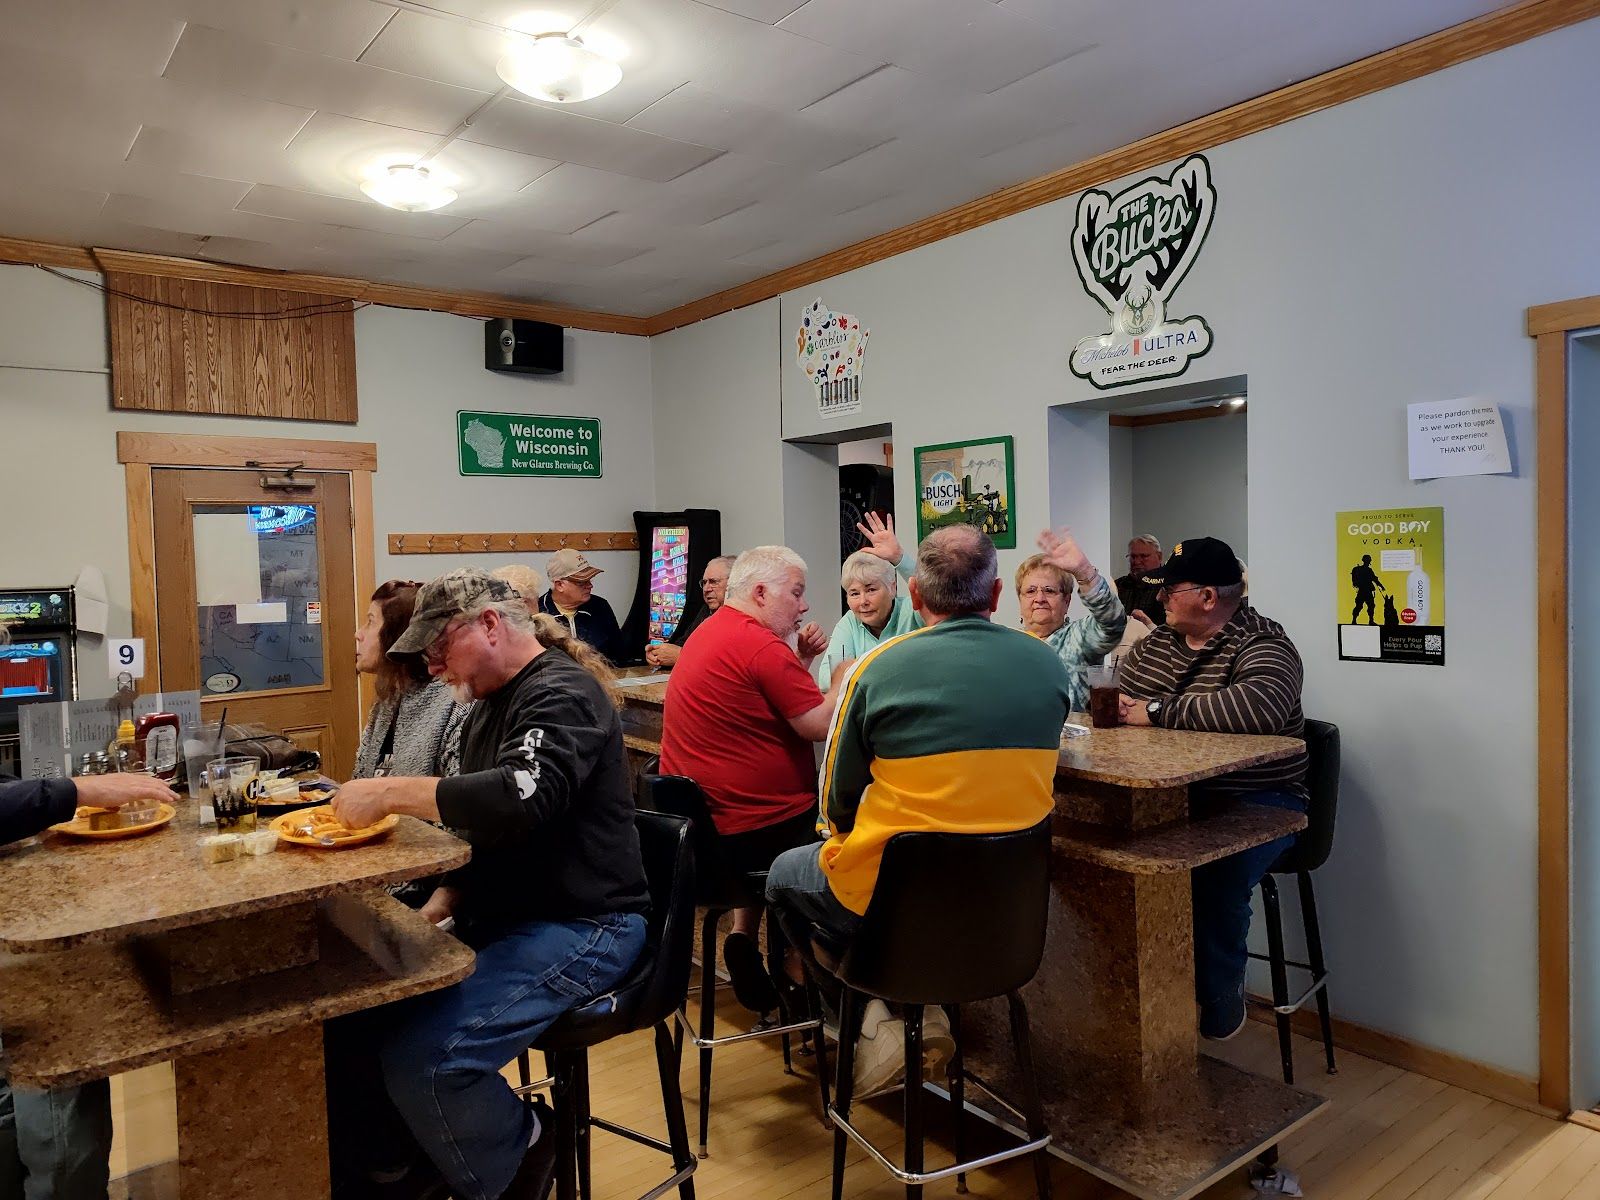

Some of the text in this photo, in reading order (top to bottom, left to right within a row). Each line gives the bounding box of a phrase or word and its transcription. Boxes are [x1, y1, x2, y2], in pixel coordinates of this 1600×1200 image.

[1120, 195, 1149, 223] THE
[1144, 330, 1198, 352] ULTRA
[1101, 364, 1126, 375] FEAR
[1128, 360, 1146, 371] THE
[1418, 413, 1443, 421] Please
[1444, 409, 1471, 419] pardon
[1443, 421, 1463, 430] work
[1464, 420, 1472, 428] to
[1472, 418, 1495, 428] upgrade
[509, 423, 593, 440] Welcome to
[1431, 431, 1489, 444] your experience
[515, 440, 589, 456] Wisconsin
[1439, 443, 1486, 454] THANK YOU!
[511, 458, 595, 472] New Glarus Brewing Co.
[926, 484, 961, 500] BUSCH
[933, 499, 954, 507] LIGHT
[1347, 520, 1431, 536] GOOD BOY
[219, 611, 233, 619] CA
[299, 635, 314, 643] NM
[1383, 641, 1402, 649] Helps
[119, 644, 135, 665] 9
